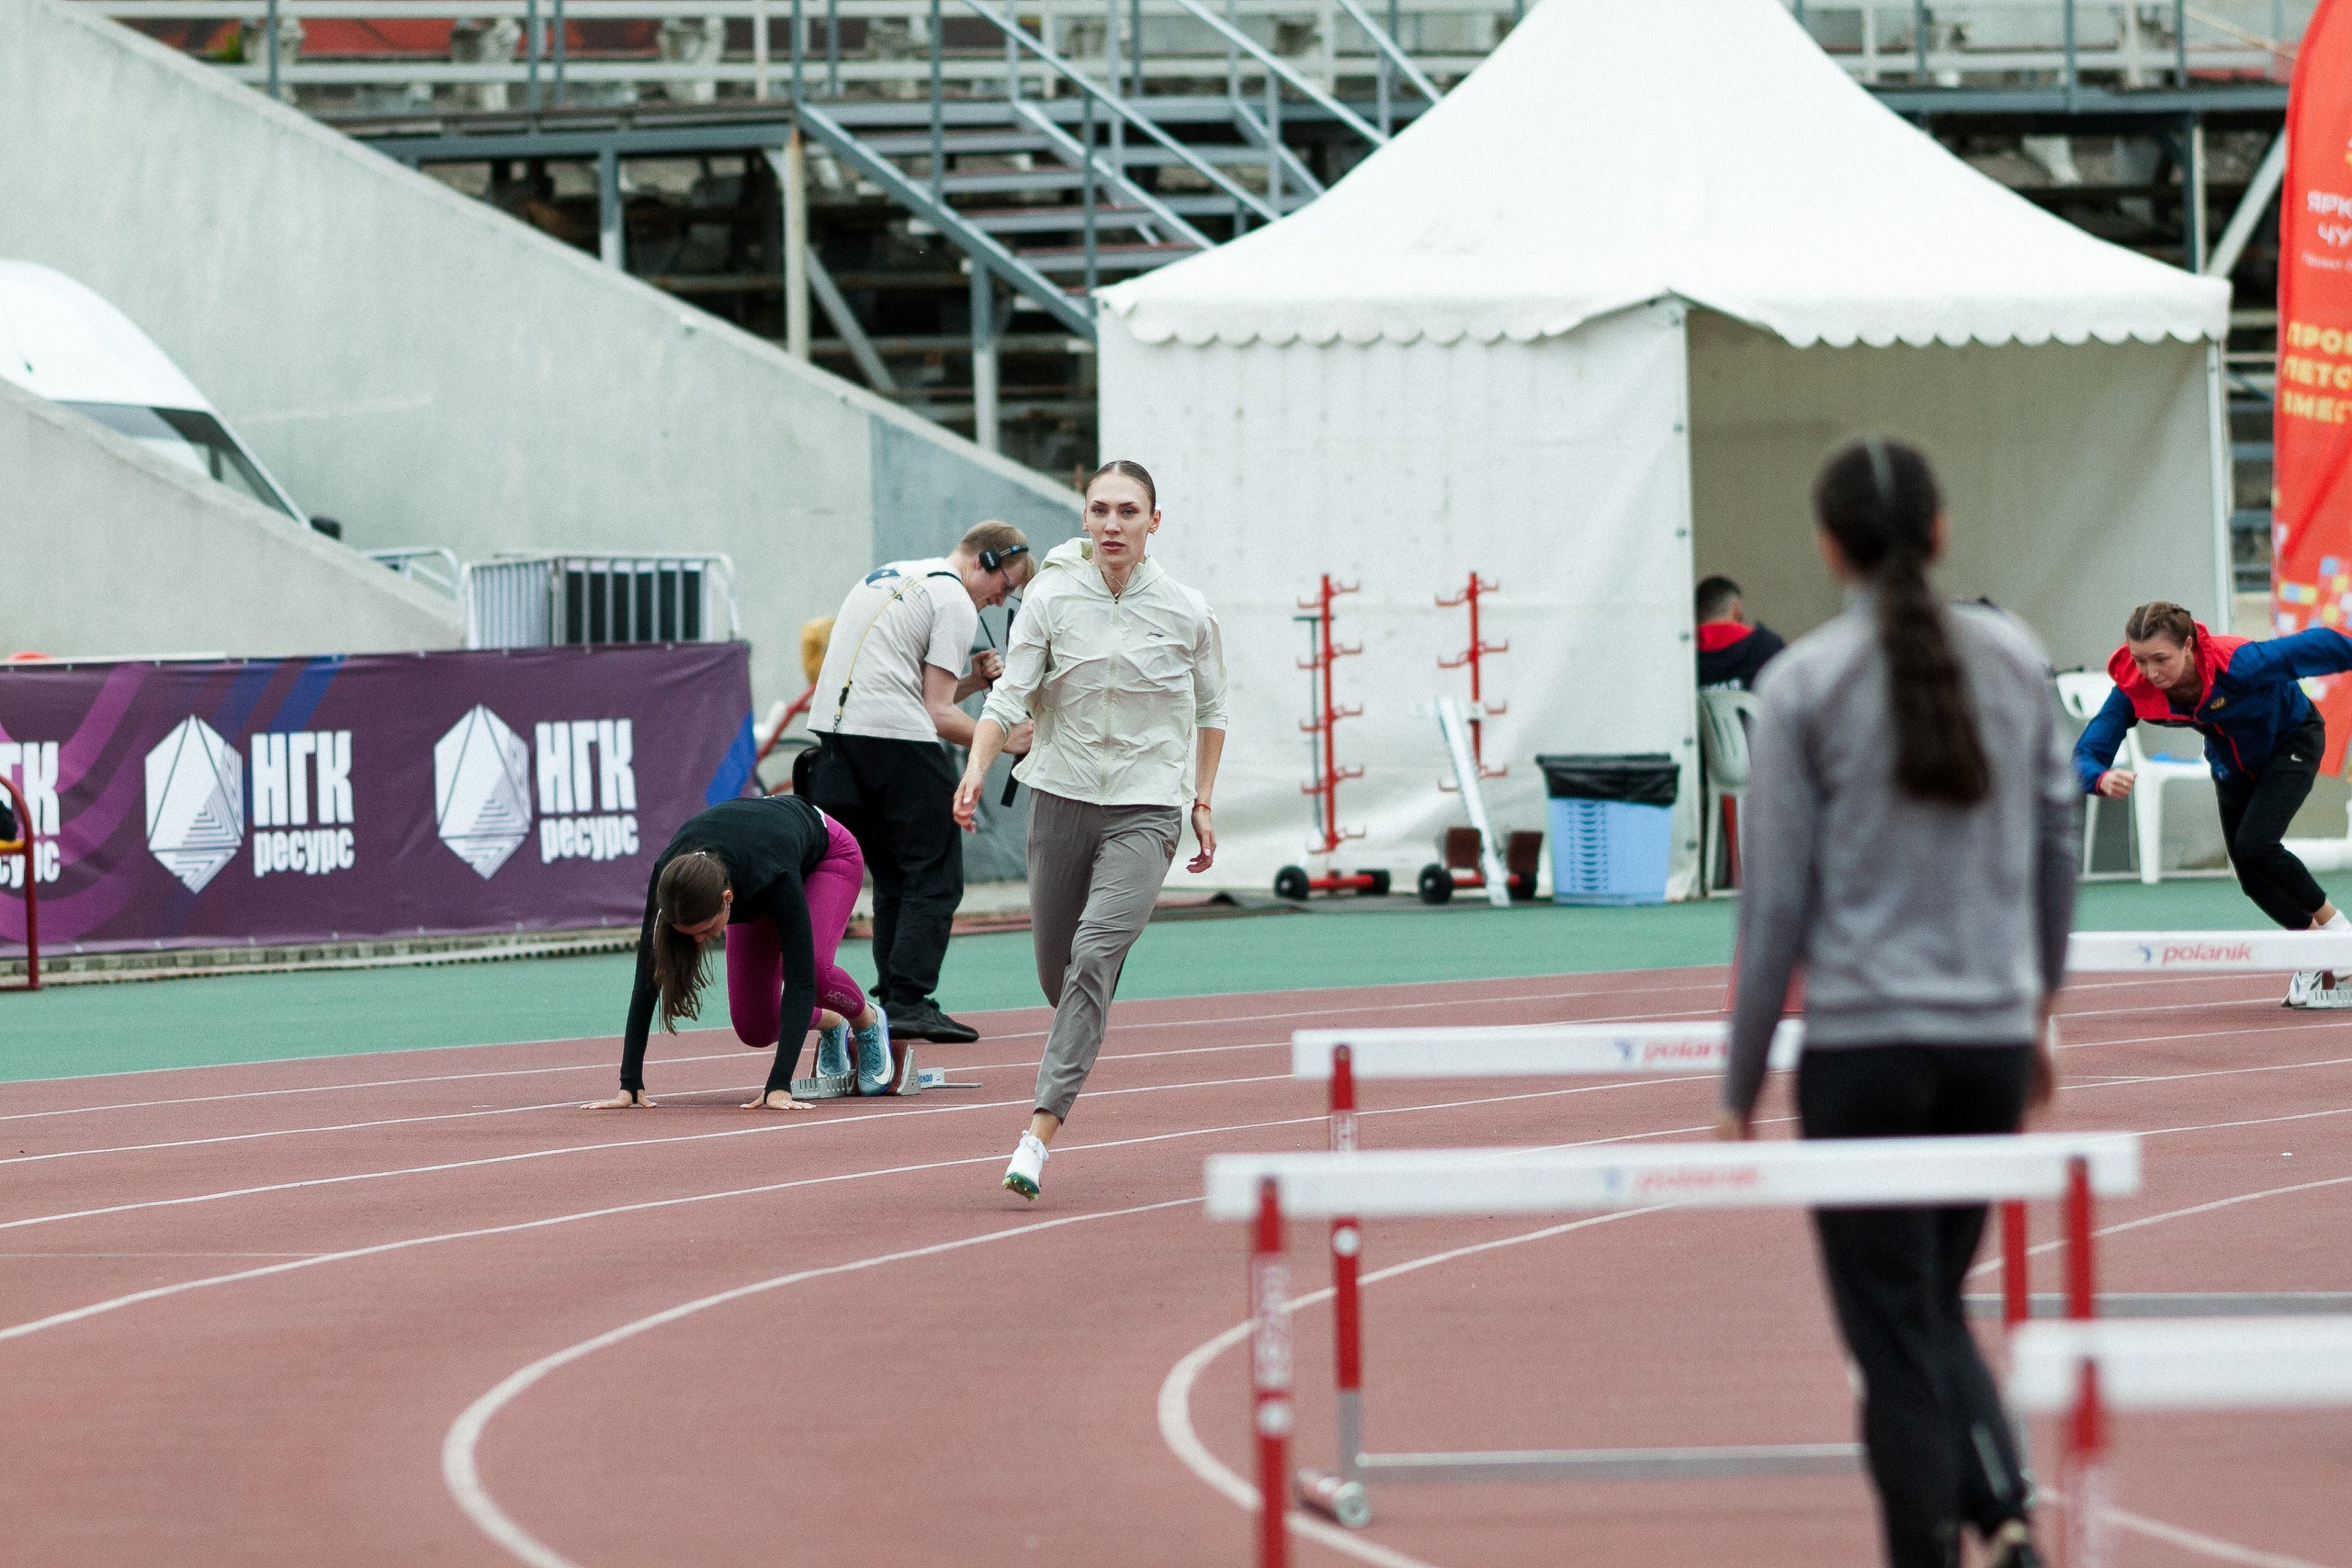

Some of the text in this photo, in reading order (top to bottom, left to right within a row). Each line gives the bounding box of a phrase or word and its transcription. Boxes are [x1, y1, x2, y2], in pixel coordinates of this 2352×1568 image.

[251, 730, 355, 827] НГК
[535, 717, 638, 814] НГК
[253, 828, 356, 879] ресурс
[538, 814, 640, 864] ресурс
[2161, 942, 2251, 965] polanik
